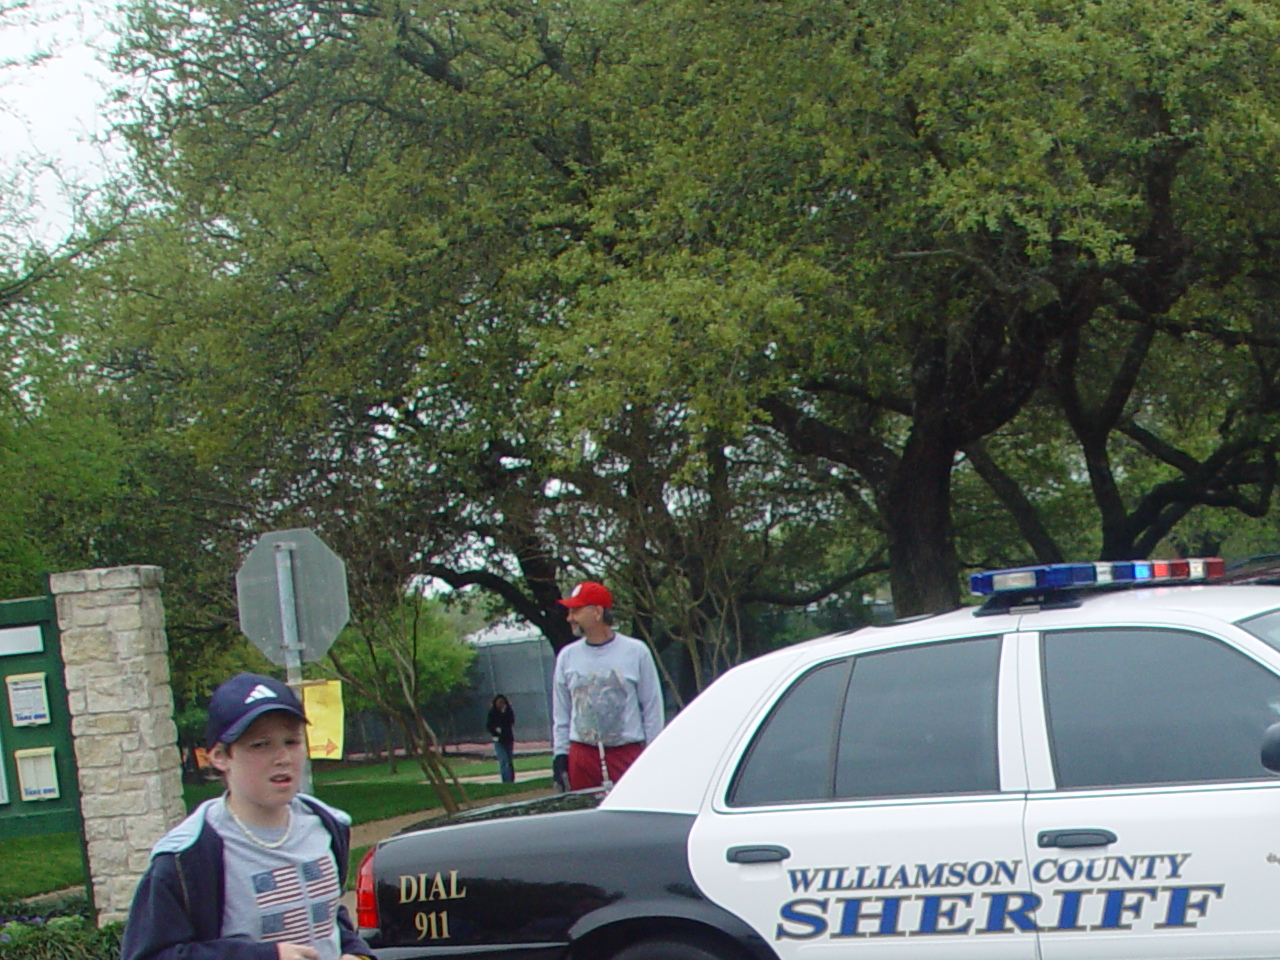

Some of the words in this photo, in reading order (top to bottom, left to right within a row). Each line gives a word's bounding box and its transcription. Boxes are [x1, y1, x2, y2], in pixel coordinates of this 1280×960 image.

[399, 869, 467, 904] DIAL
[788, 860, 1022, 893] WILLIAMSON
[1032, 853, 1191, 883] COUNTY
[414, 910, 451, 940] 911
[775, 883, 1225, 941] SHERIFF
